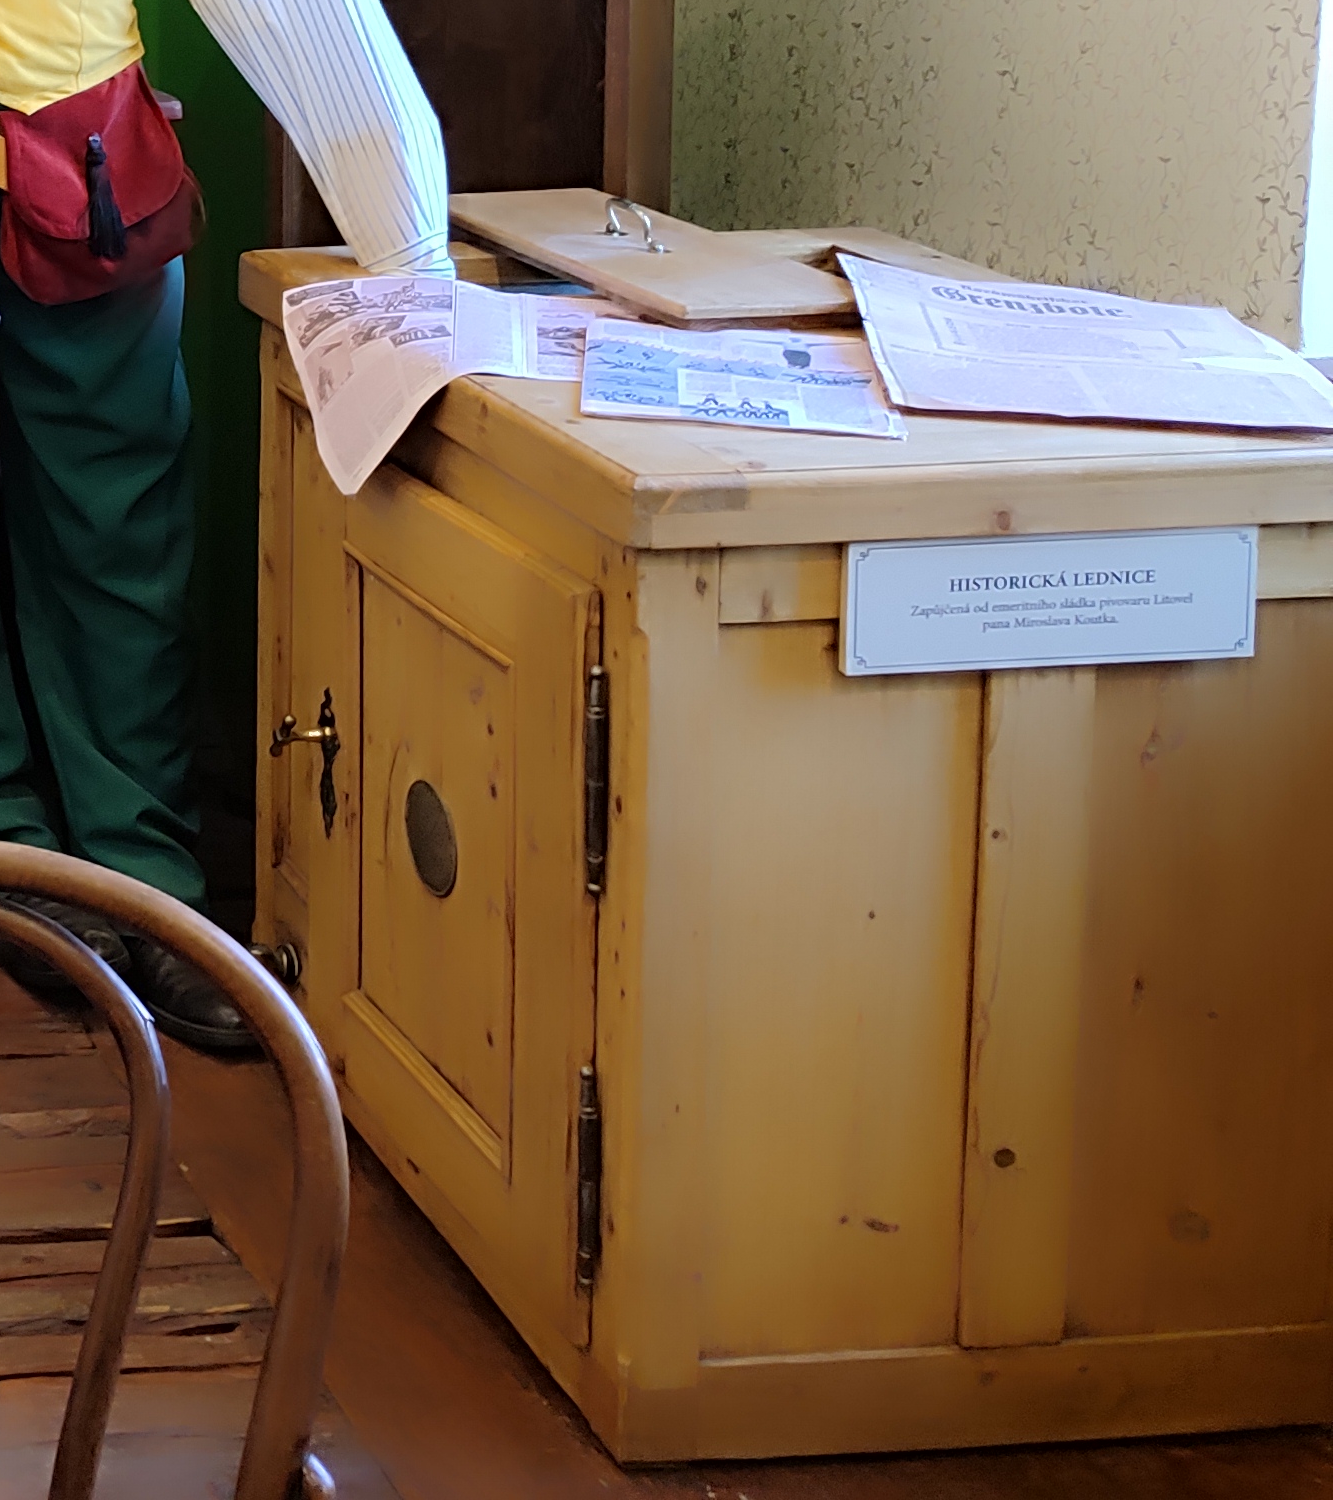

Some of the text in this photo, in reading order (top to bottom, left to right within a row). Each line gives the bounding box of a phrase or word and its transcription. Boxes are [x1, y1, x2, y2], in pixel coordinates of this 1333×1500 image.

[949, 569, 1156, 592] HISTORICKÁ LEDNICE
[973, 601, 989, 613] od
[992, 599, 1056, 613] emeritního
[1059, 597, 1096, 609] sládka
[1099, 596, 1151, 611] pivovaru
[1154, 592, 1194, 605] Litovel
[982, 618, 1011, 633] pana
[1014, 614, 1071, 628] Miroslava
